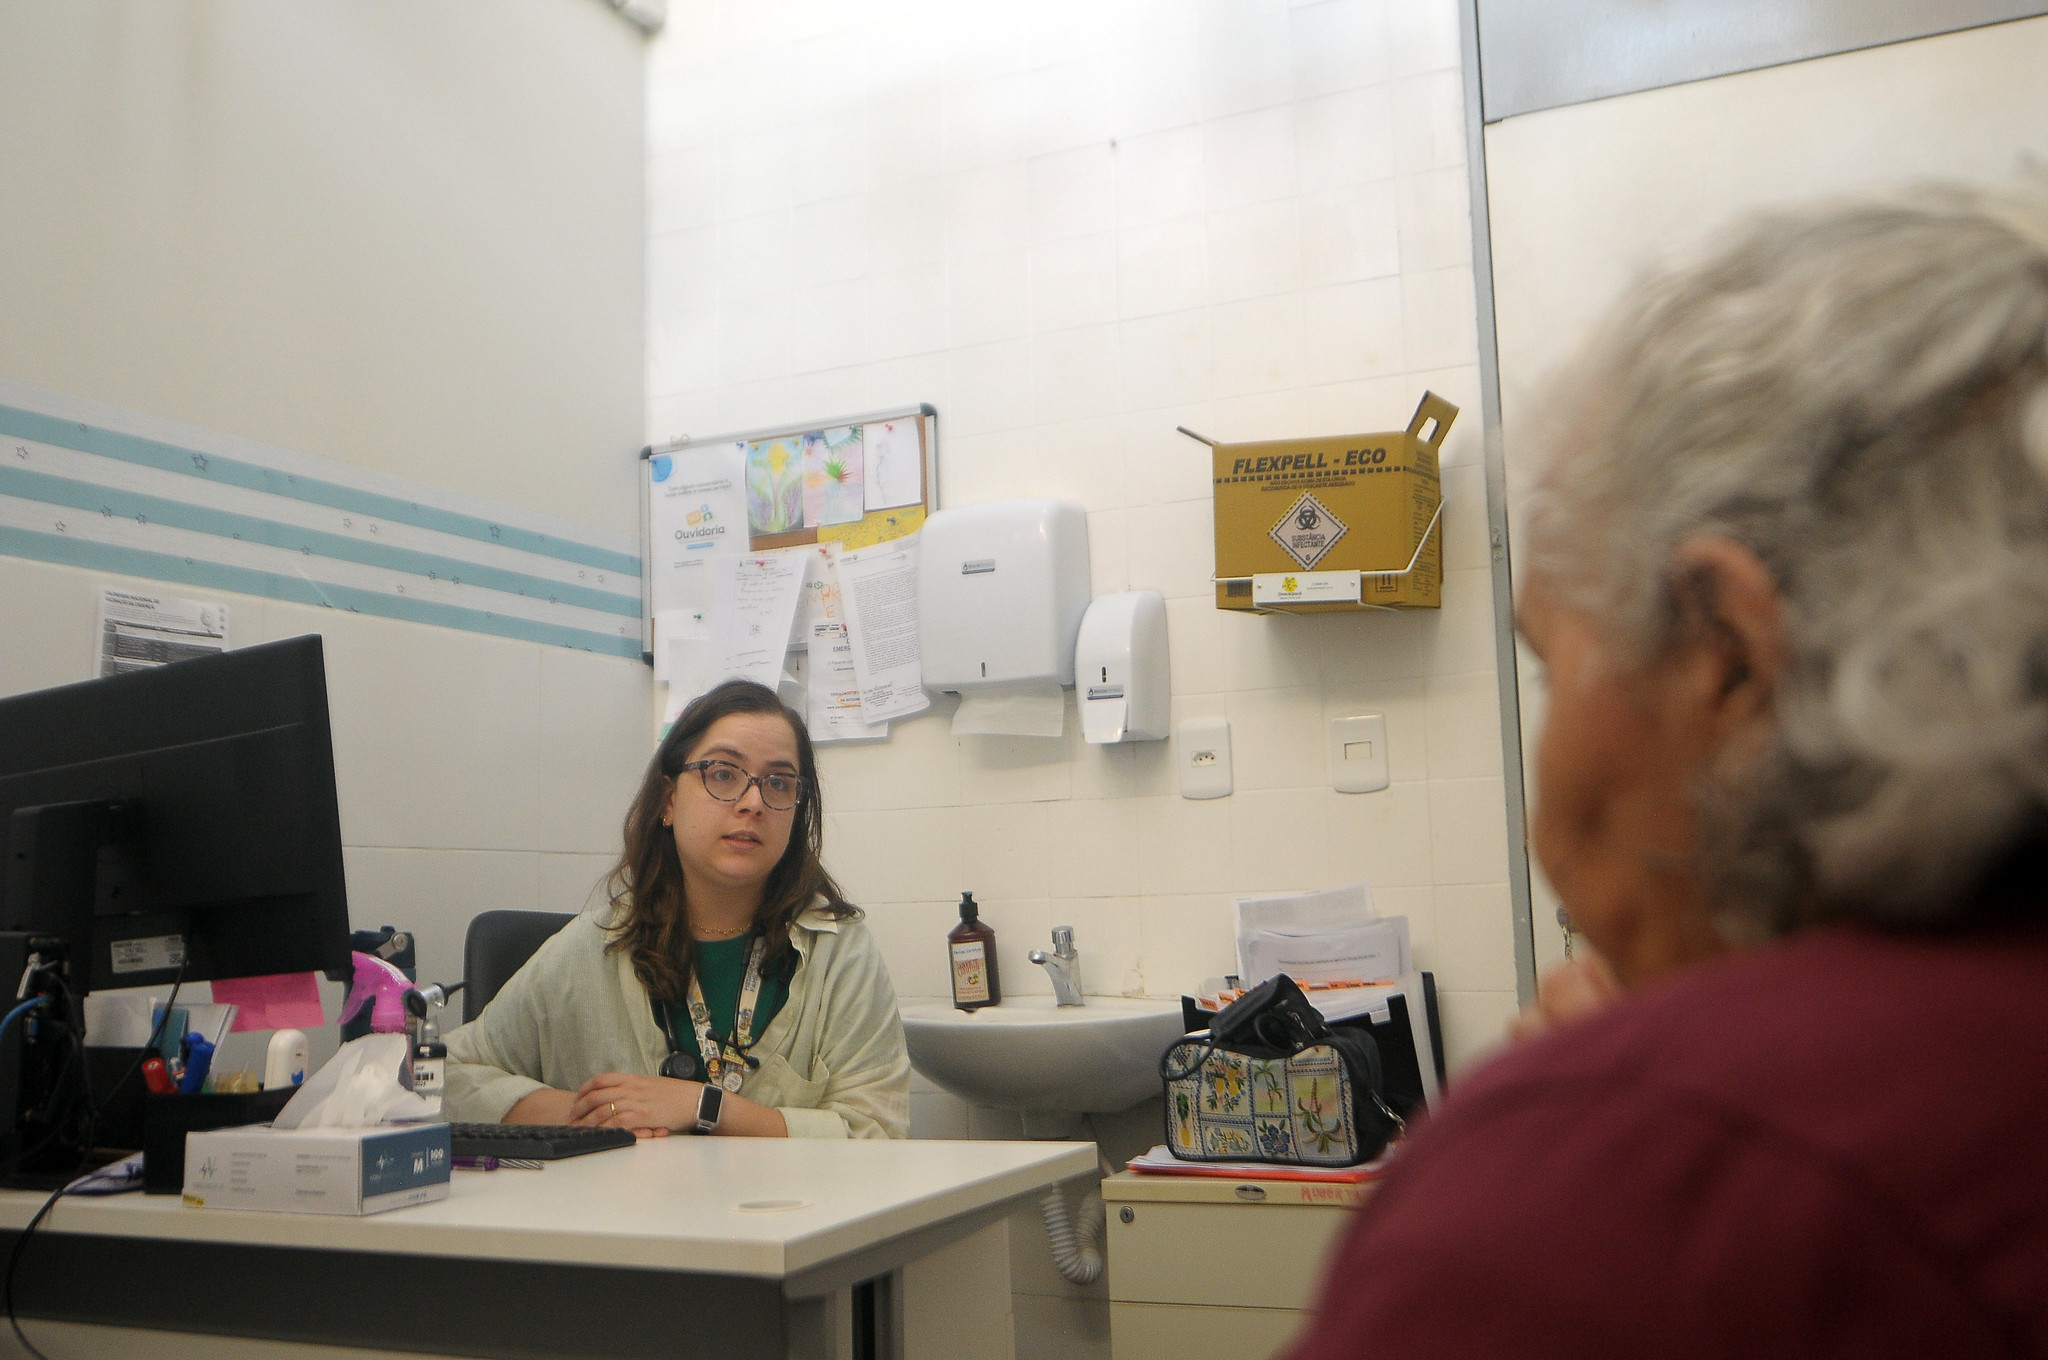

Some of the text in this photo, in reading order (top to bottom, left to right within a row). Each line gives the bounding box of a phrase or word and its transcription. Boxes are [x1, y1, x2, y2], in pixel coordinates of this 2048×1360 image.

[1233, 452, 1327, 475] FLEXPELL
[1345, 447, 1387, 466] ECO
[674, 524, 725, 540] Ouvidoria
[1291, 532, 1326, 542] SUBSTÂNCIA
[1291, 540, 1325, 549] INFECTANTE
[413, 1157, 424, 1175] M
